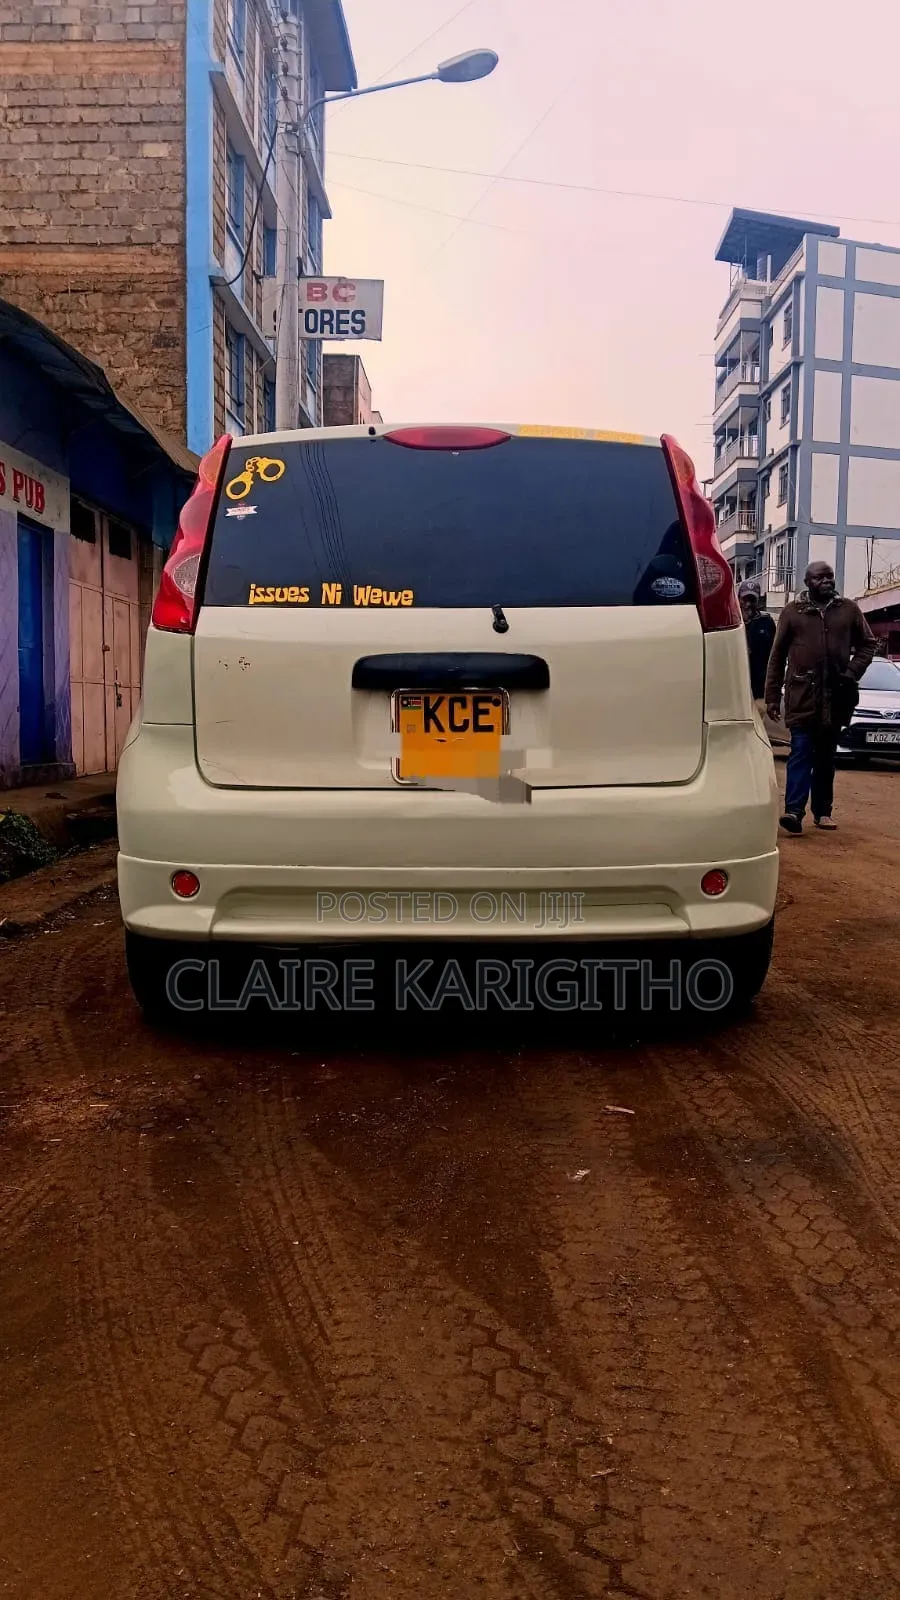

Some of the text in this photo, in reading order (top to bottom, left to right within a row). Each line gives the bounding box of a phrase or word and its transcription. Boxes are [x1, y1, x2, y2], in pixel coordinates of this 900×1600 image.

[12, 467, 45, 514] PUB
[248, 582, 414, 606] issues Ni Wewe
[423, 696, 494, 733] KCE
